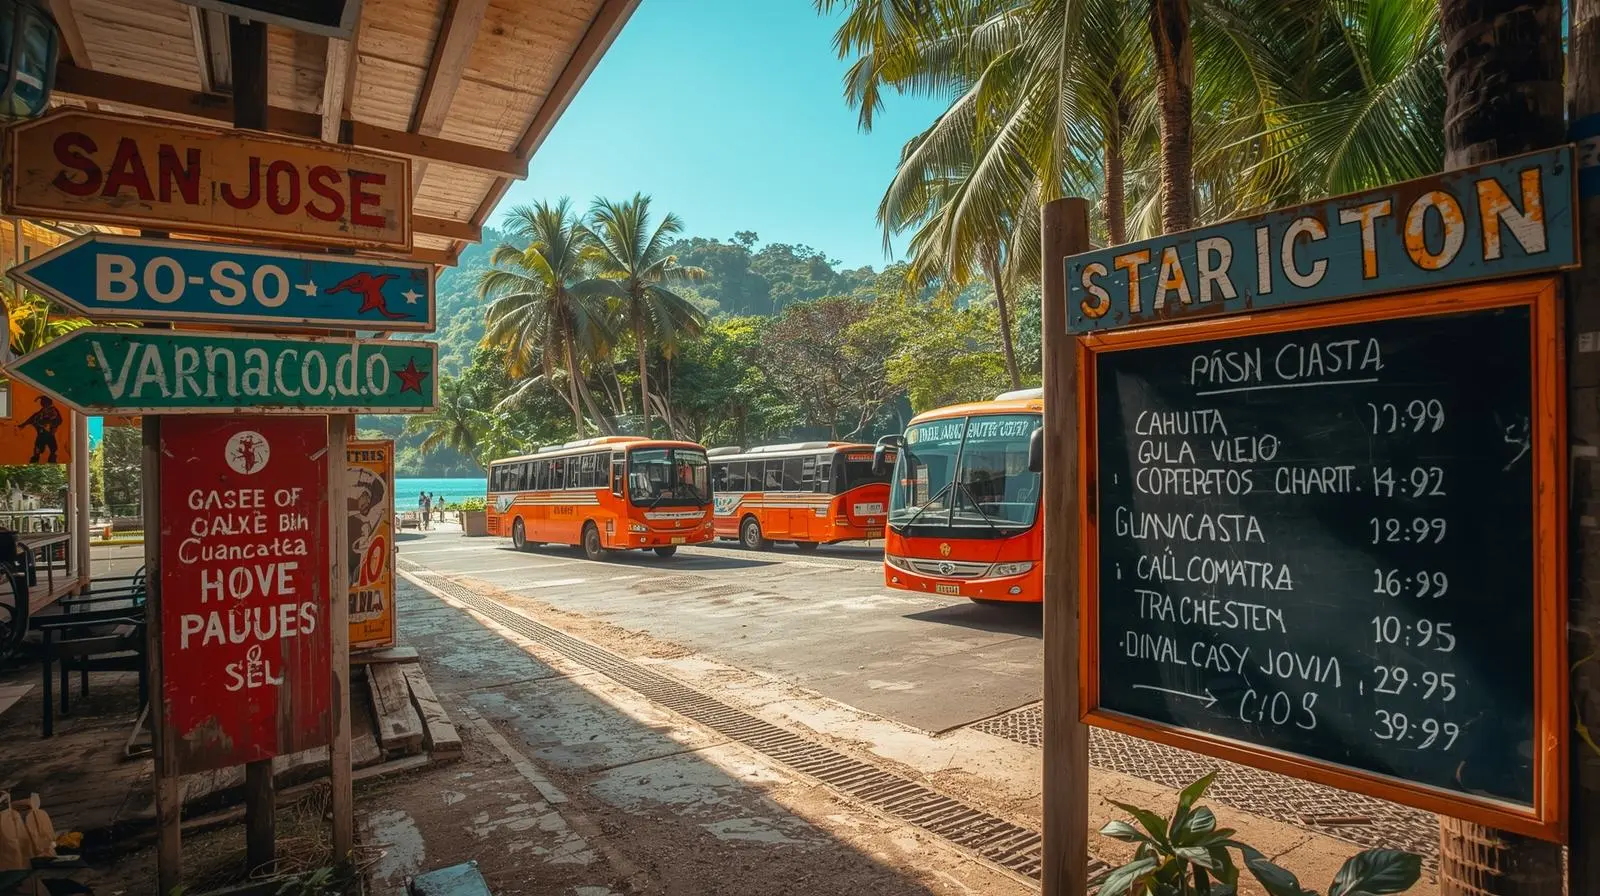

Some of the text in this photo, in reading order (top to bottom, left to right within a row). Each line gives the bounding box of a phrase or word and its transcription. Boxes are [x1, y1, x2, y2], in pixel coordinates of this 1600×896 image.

[53, 131, 387, 229] SAN JOSE
[95, 252, 290, 308] BO-SO
[1135, 409, 1228, 436] CAHUITA
[274, 488, 303, 508] OF
[1370, 517, 1446, 544] 12:99
[201, 562, 298, 604] HOVE
[1373, 568, 1449, 598] 16:99
[1371, 615, 1456, 652] 10:95
[1374, 709, 1460, 751] 39:99
